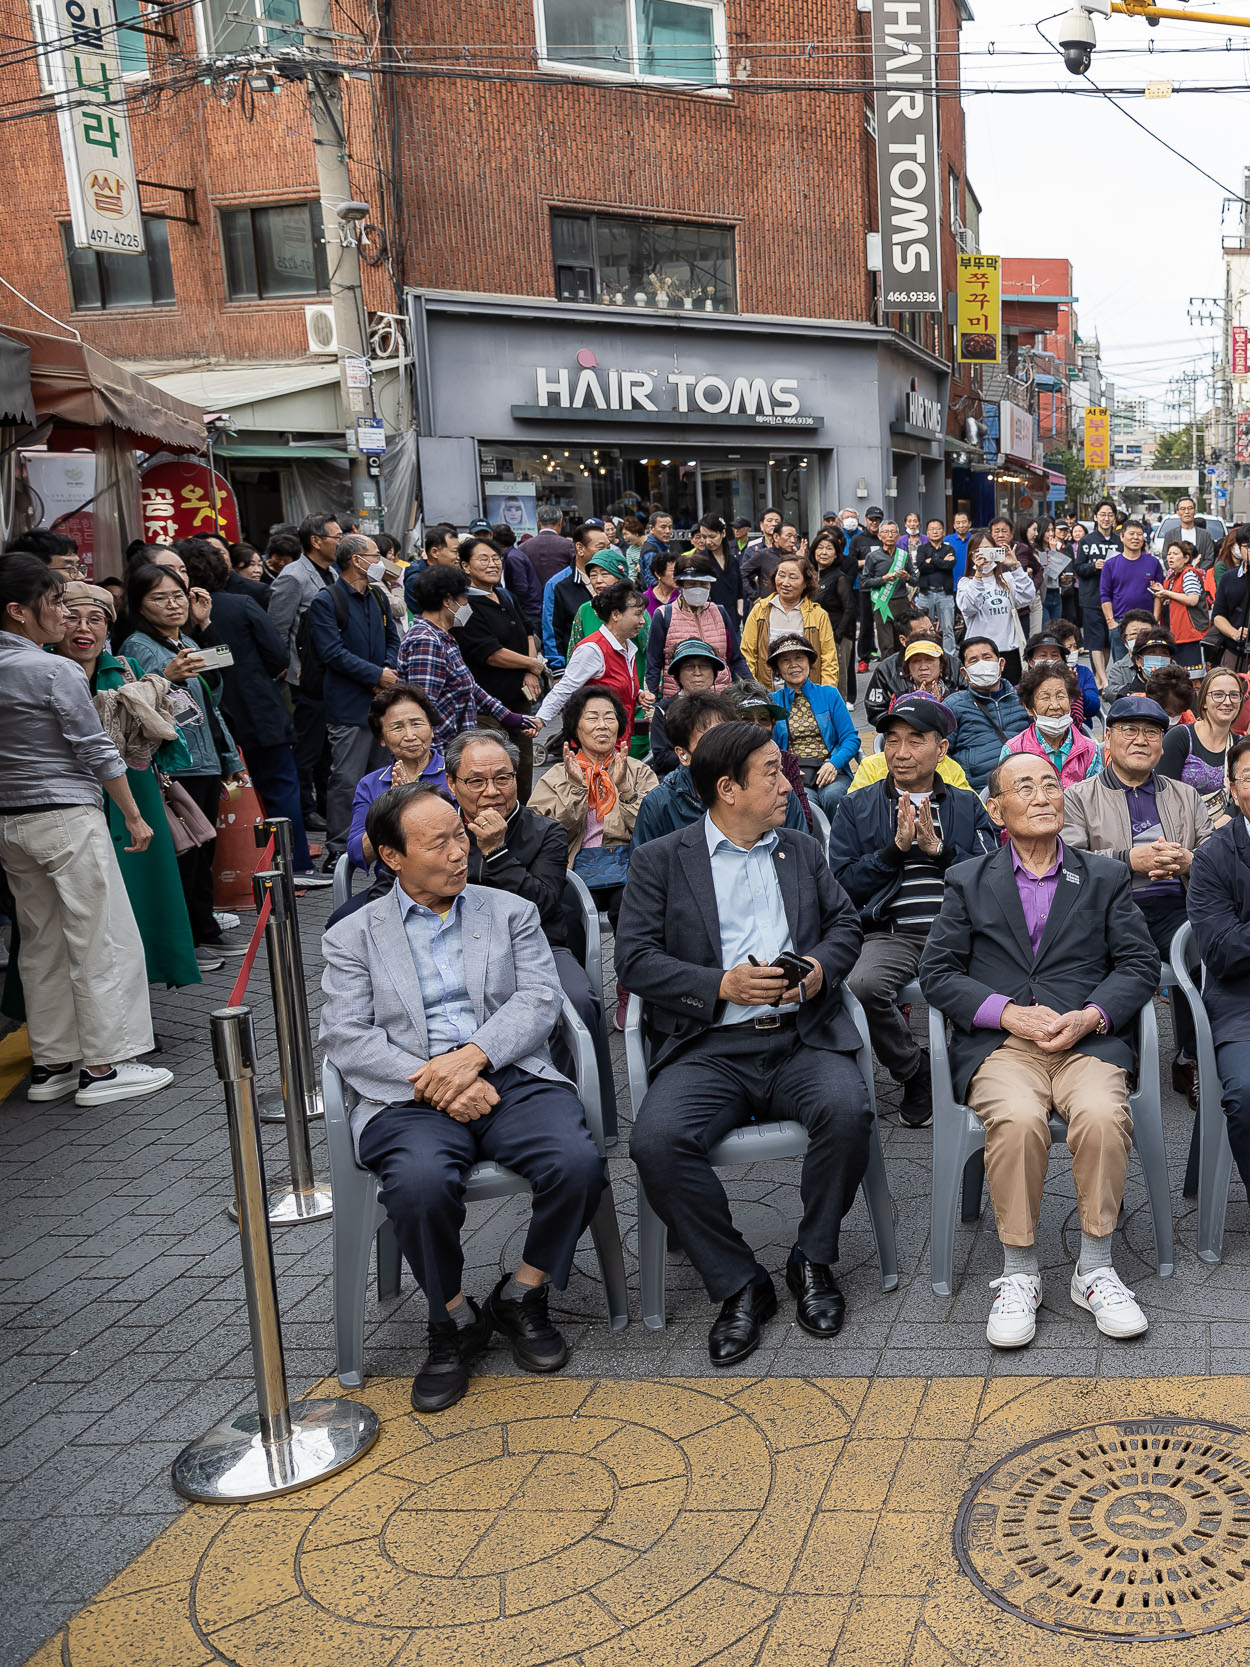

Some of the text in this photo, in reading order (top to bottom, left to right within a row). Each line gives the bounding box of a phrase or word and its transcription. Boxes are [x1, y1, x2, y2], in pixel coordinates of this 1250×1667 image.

[883, 1, 931, 274] HAIR TOMS
[90, 174, 125, 215] 쌀
[90, 228, 140, 249] 497-4225
[959, 256, 999, 271] 부뚜막
[886, 291, 937, 303] 466.9336
[964, 272, 991, 333] 쭈꾸미
[536, 367, 801, 417] HAIR TOMS
[784, 416, 814, 425] 466.9336
[910, 391, 925, 429] HAIR
[1088, 418, 1106, 464] 부동산
[988, 605, 1009, 616] TRACK
[868, 688, 884, 703] 45
